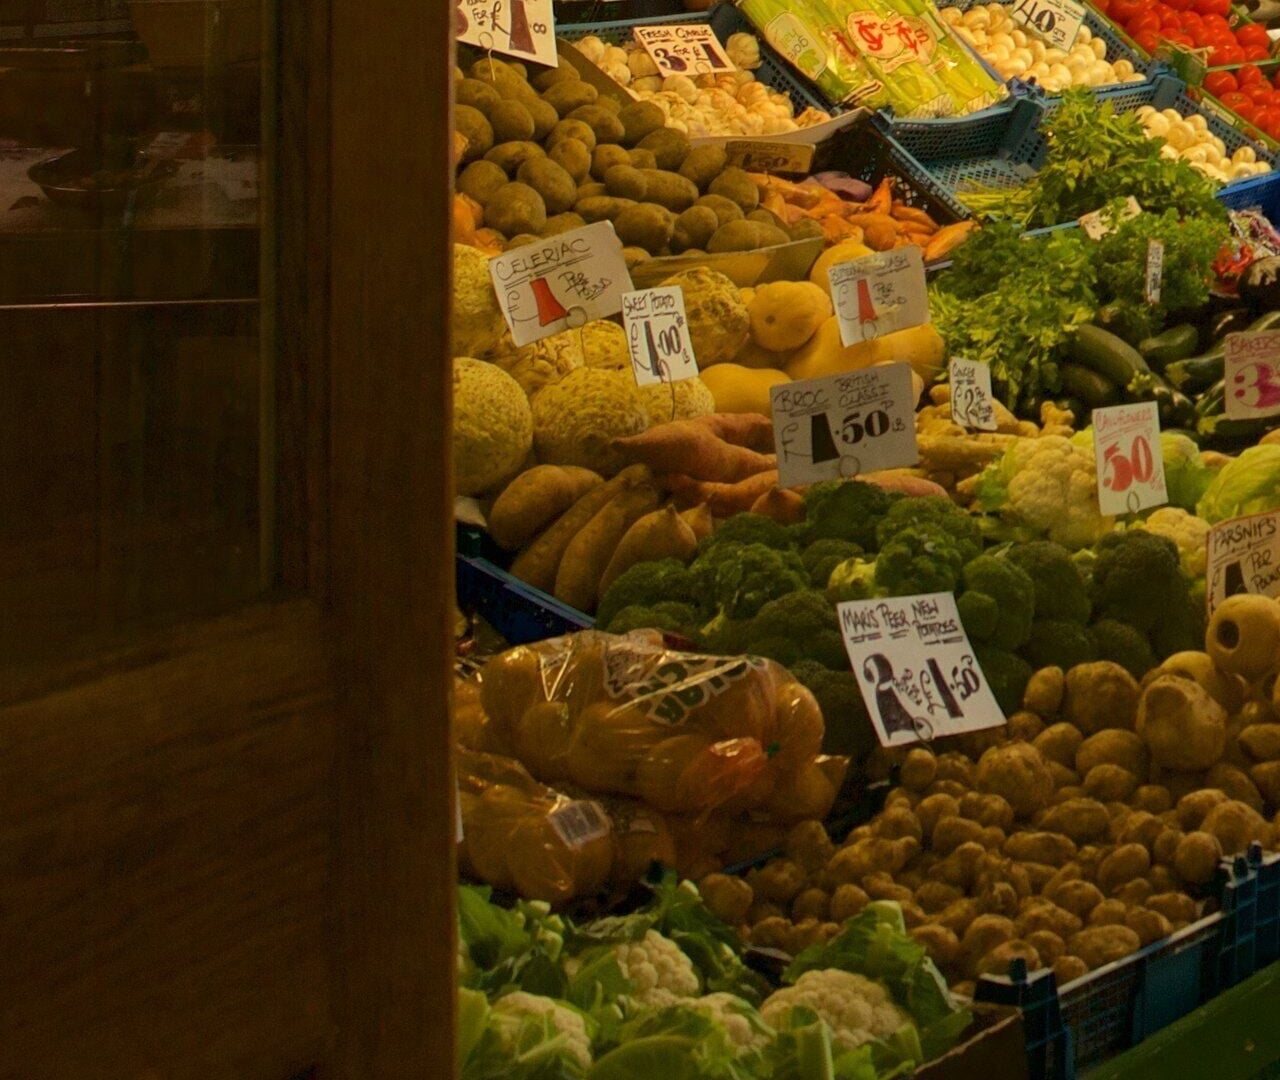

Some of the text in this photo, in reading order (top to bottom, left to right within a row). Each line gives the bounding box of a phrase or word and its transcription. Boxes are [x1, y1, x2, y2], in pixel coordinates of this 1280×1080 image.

[653, 47, 688, 72] 3
[496, 237, 591, 281] CELERIAC
[834, 372, 880, 391] BRITISH
[774, 389, 829, 414] BROC
[1246, 549, 1272, 571] PER
[842, 598, 939, 634] MARIS PEER NEW
[912, 618, 959, 640] POTATOES
[863, 653, 923, 741] 2
